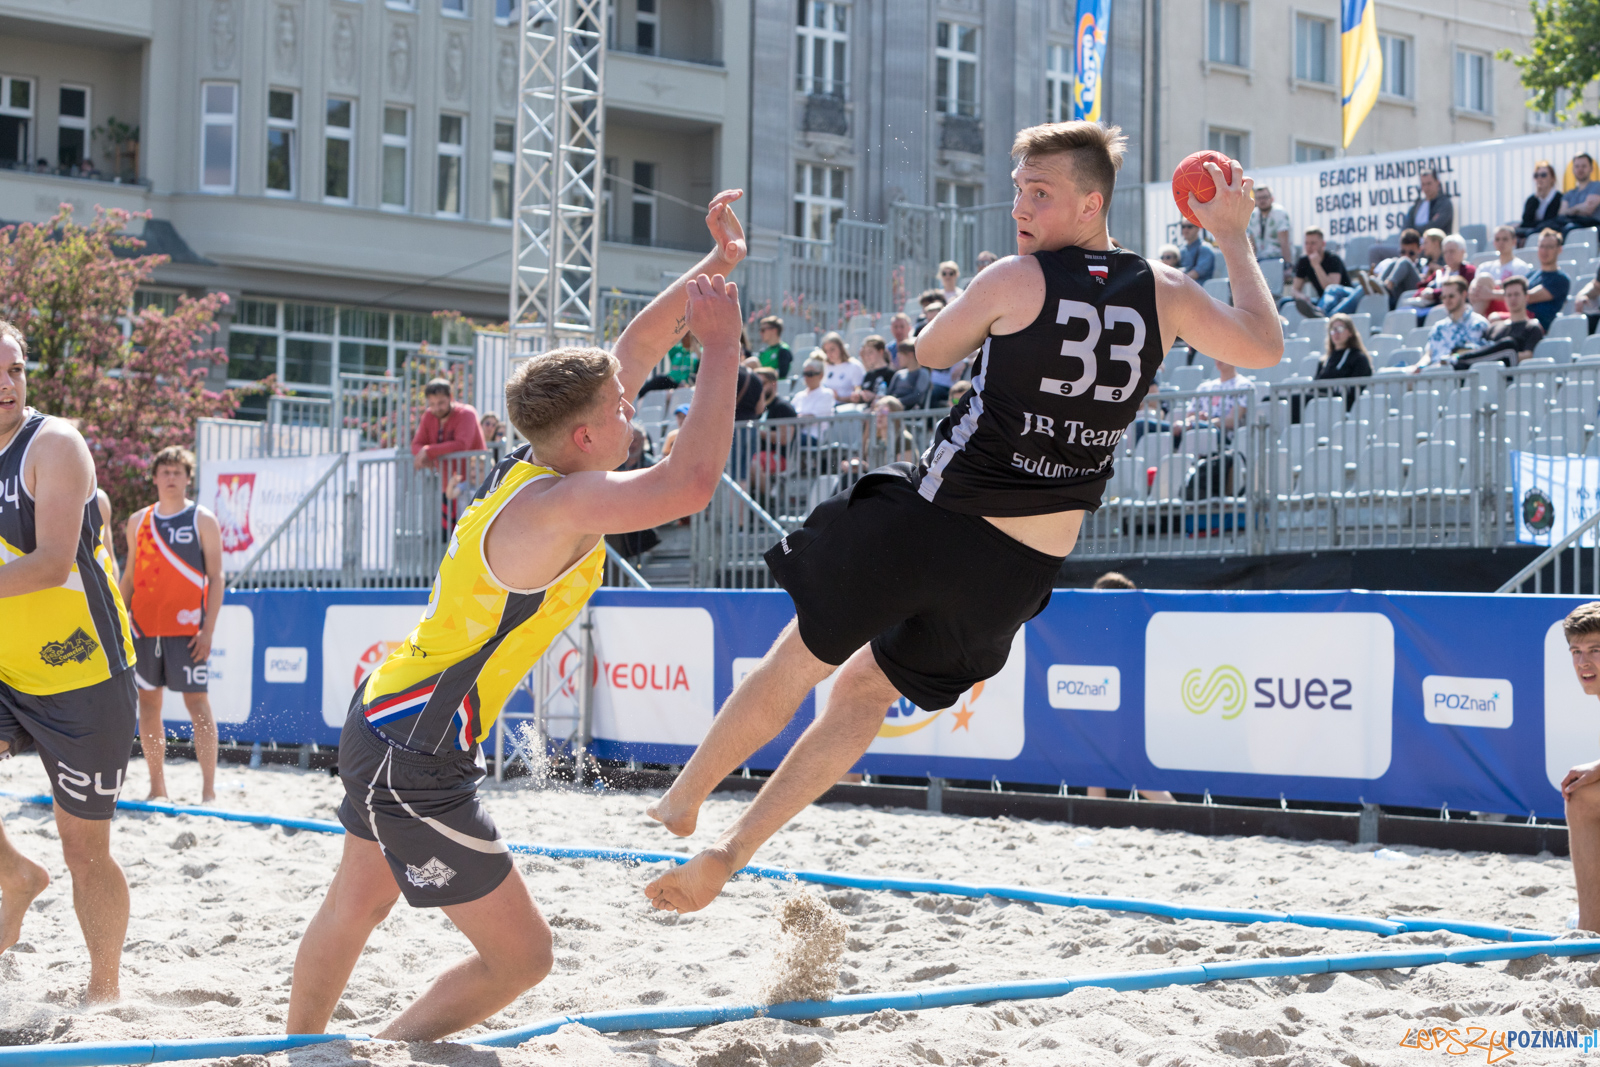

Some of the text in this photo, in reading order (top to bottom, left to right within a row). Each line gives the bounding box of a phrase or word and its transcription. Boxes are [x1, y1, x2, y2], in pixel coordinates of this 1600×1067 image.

[1320, 165, 1367, 188] BEACH
[1316, 180, 1461, 213] BEACH VOLLEYLL
[1330, 214, 1378, 236] BEACH
[1039, 299, 1146, 403] 33
[1020, 412, 1055, 437] JB
[0, 475, 20, 513] 4
[168, 526, 193, 544] 16
[780, 537, 793, 555] mel
[183, 665, 208, 685] 16
[1255, 678, 1352, 710] suez
[58, 761, 122, 803] 24
